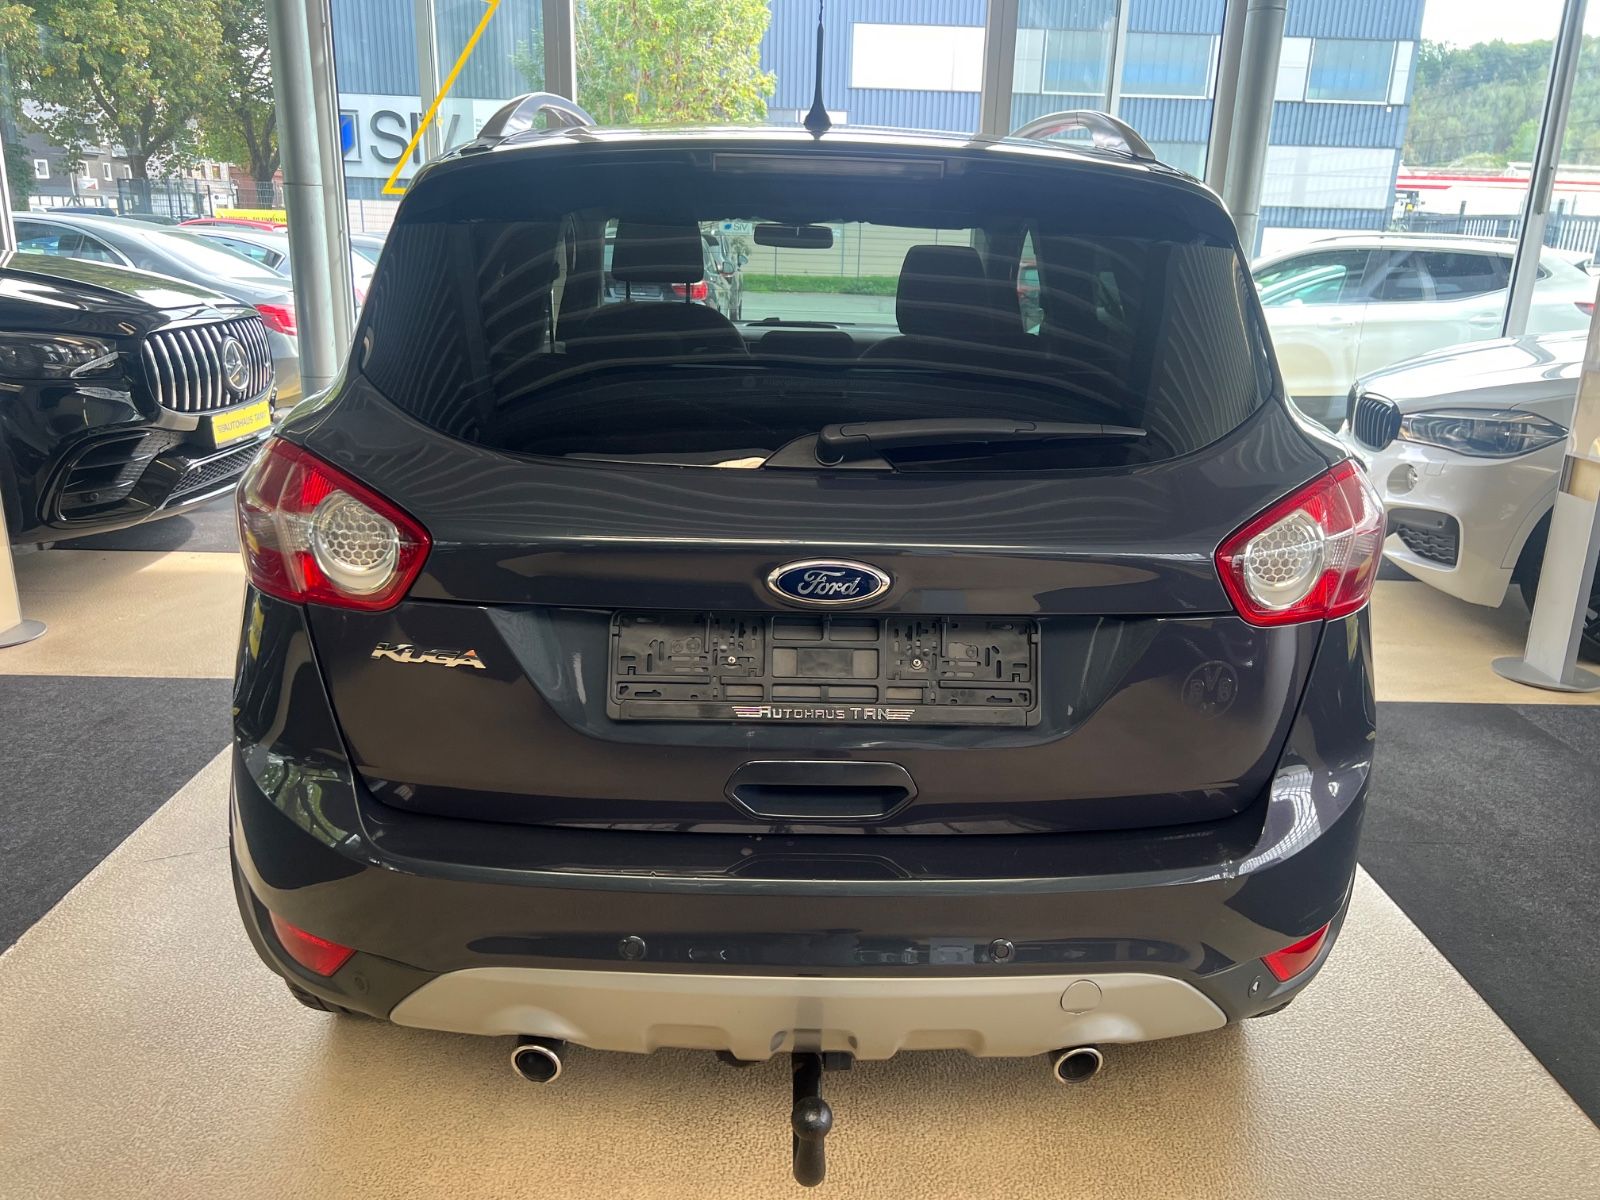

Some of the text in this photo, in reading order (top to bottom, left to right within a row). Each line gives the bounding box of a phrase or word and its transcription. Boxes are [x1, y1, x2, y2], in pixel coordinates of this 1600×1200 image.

[797, 570, 862, 595] Ford
[760, 706, 889, 720] AUTOHAUS TAN
